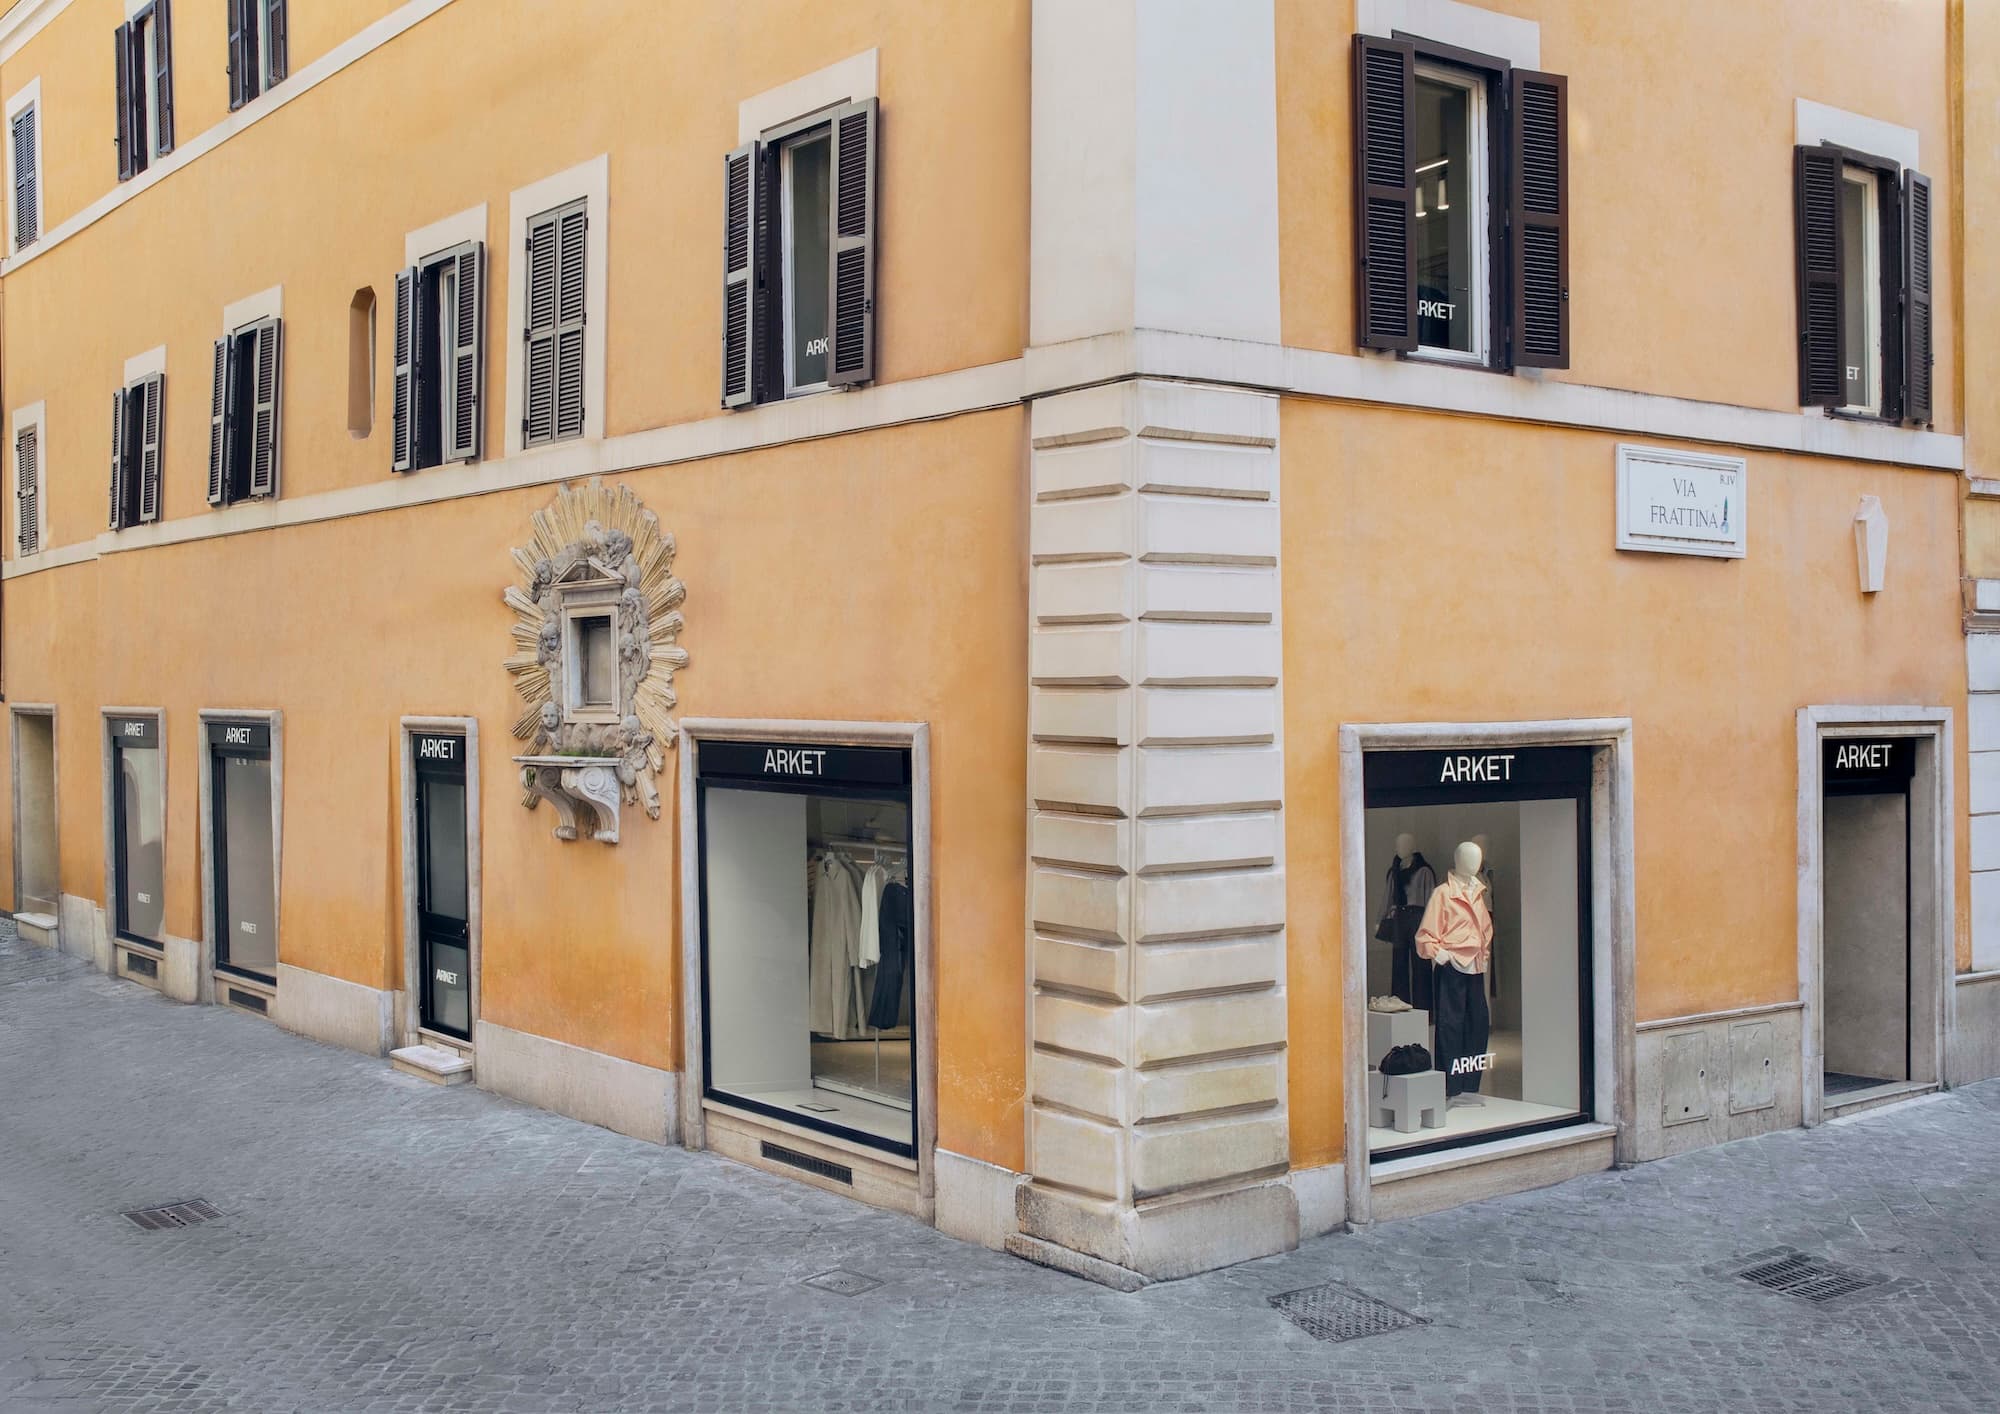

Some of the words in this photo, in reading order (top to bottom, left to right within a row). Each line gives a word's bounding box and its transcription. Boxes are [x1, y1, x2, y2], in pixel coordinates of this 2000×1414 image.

[805, 337, 829, 357] ARK
[1673, 478, 1696, 498] VIA
[1650, 505, 1718, 529] FRATTINA
[124, 722, 145, 737] ARKET
[225, 727, 251, 745] ARKET
[420, 738, 456, 759] ARKET
[1835, 744, 1893, 768] ARKET
[763, 748, 826, 775] ARKET
[1440, 754, 1515, 782] ARKET
[435, 968, 458, 985] ARKET
[1450, 1052, 1497, 1076] ARKET
